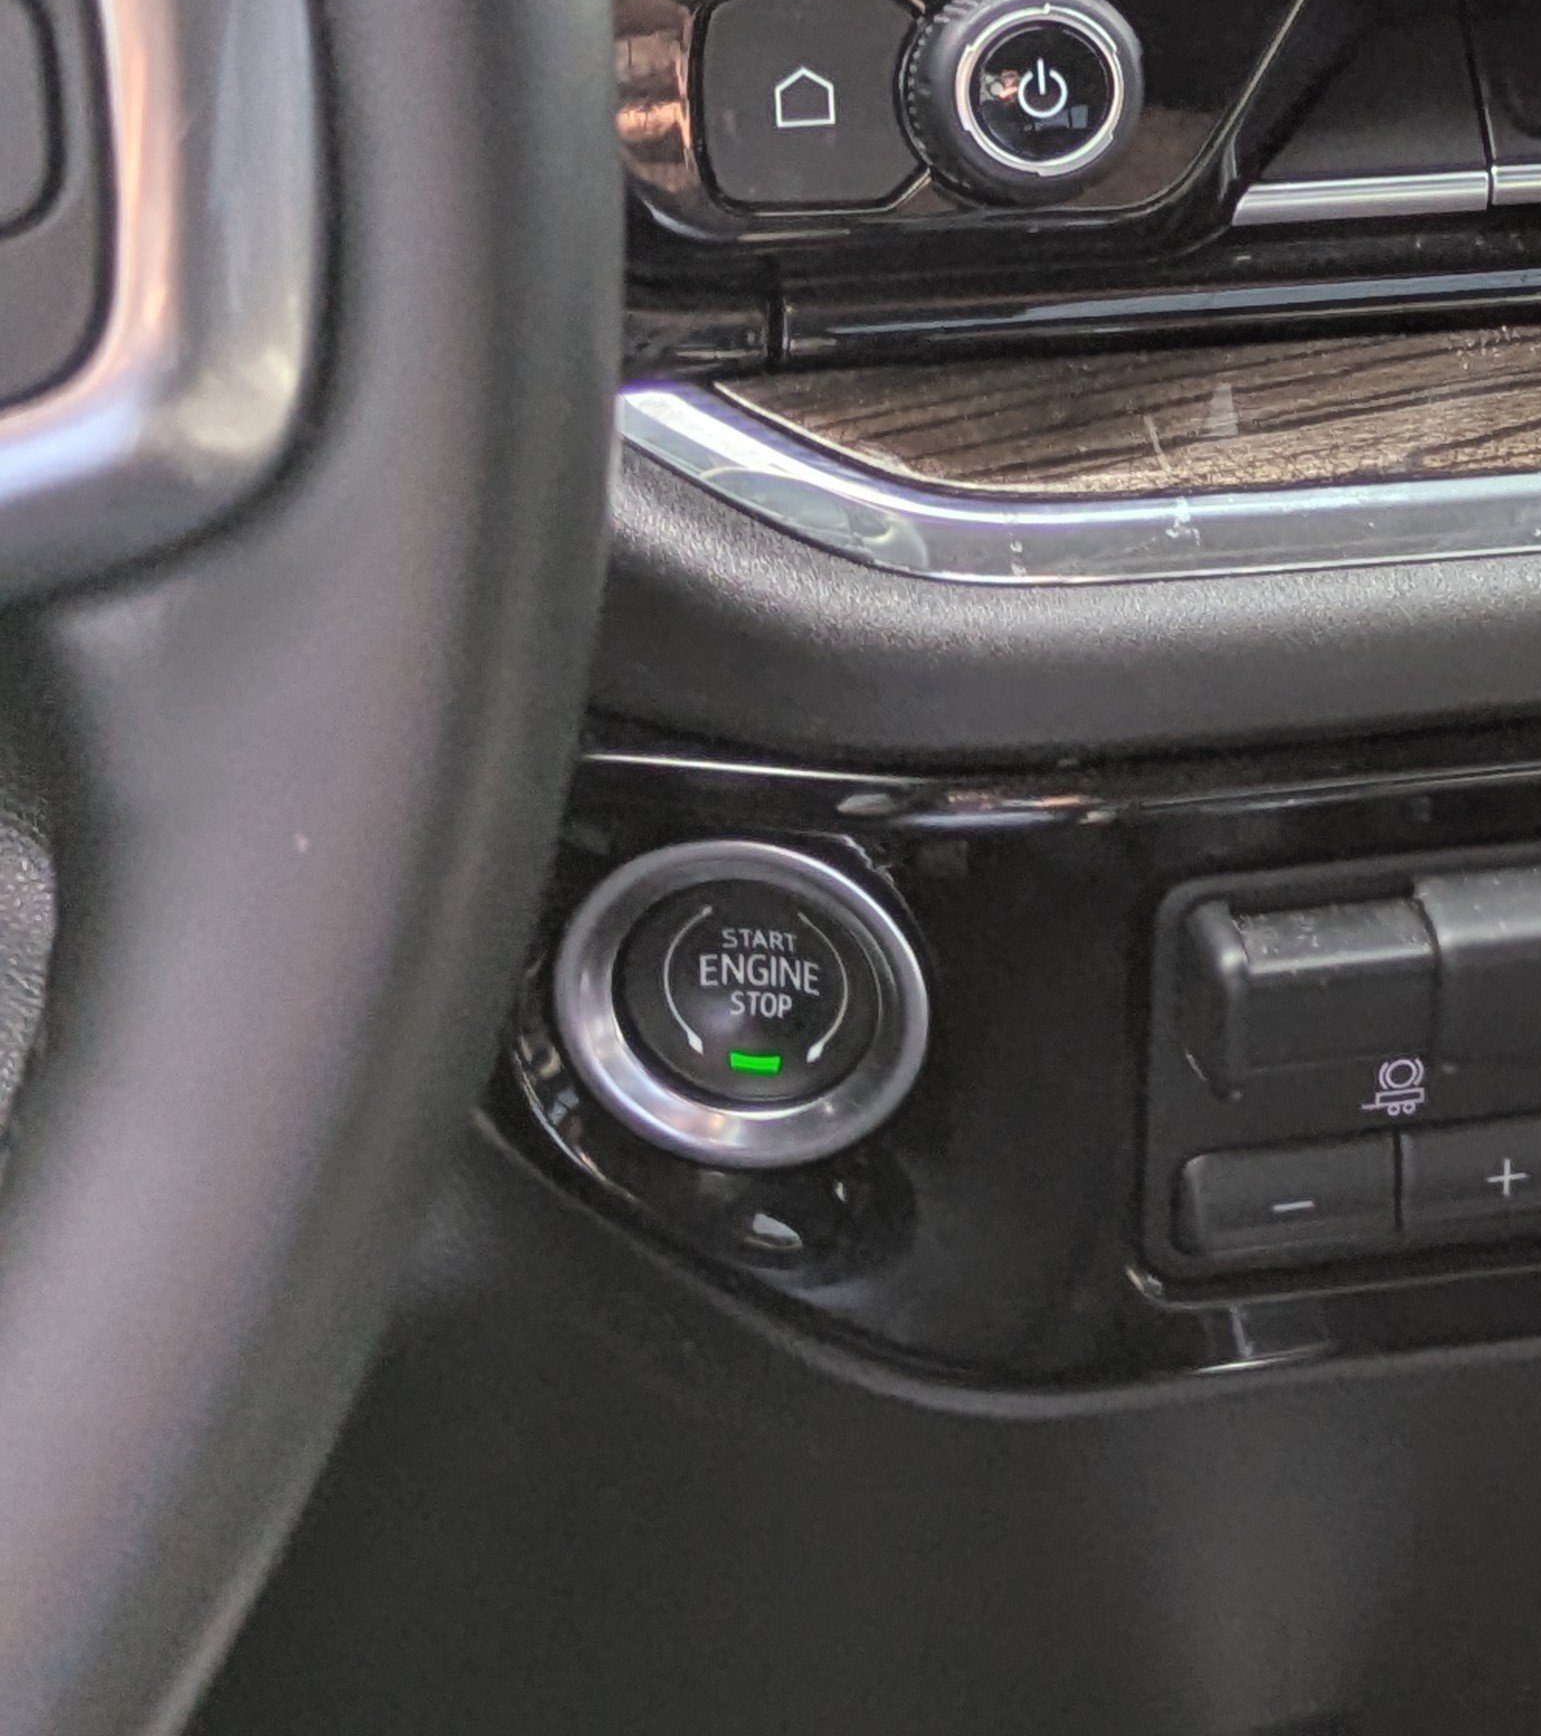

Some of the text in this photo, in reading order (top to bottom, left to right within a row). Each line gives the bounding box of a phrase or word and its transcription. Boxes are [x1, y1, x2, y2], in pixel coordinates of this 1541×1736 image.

[721, 927, 797, 953] START
[699, 953, 820, 996] ENGINE
[729, 989, 792, 1019] STOP
